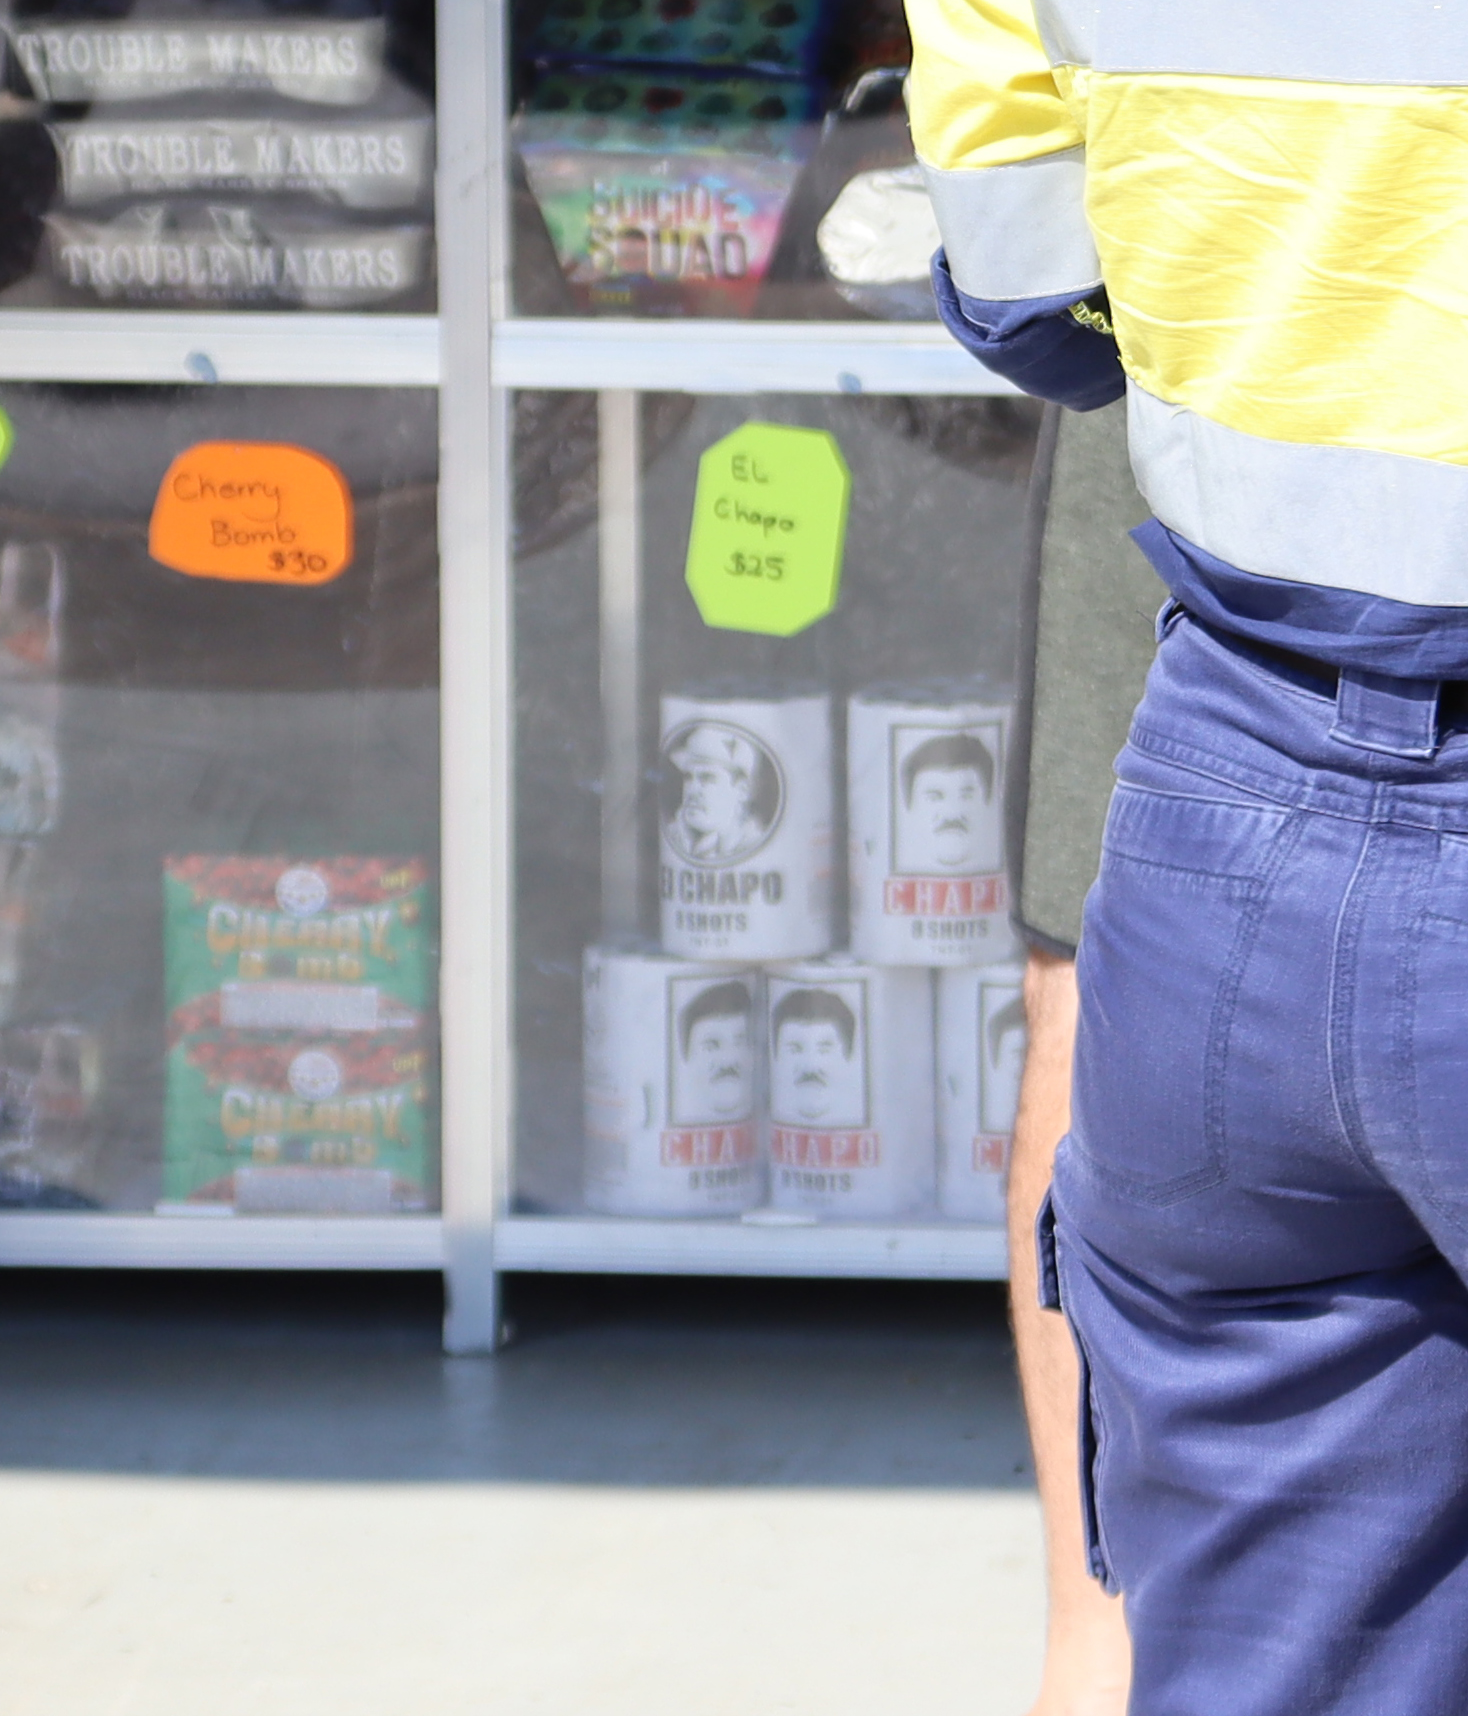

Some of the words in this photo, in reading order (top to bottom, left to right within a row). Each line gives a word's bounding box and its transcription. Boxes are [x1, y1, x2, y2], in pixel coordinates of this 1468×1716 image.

[16, 32, 188, 76] TROUBLE
[206, 34, 360, 77] MAKERS
[69, 134, 236, 176] TROUBLE
[254, 134, 408, 176] MAKERS
[61, 244, 228, 287] TROUBLE
[248, 246, 402, 288] MAKERS
[172, 472, 281, 523] Cherry
[209, 519, 296, 548] Bomb
[713, 496, 795, 538] Chapo
[266, 550, 328, 576] $30
[724, 550, 785, 582] $25
[679, 869, 784, 905] CHAPO
[686, 912, 748, 932] SHOTS
[927, 919, 988, 940] SHOTS
